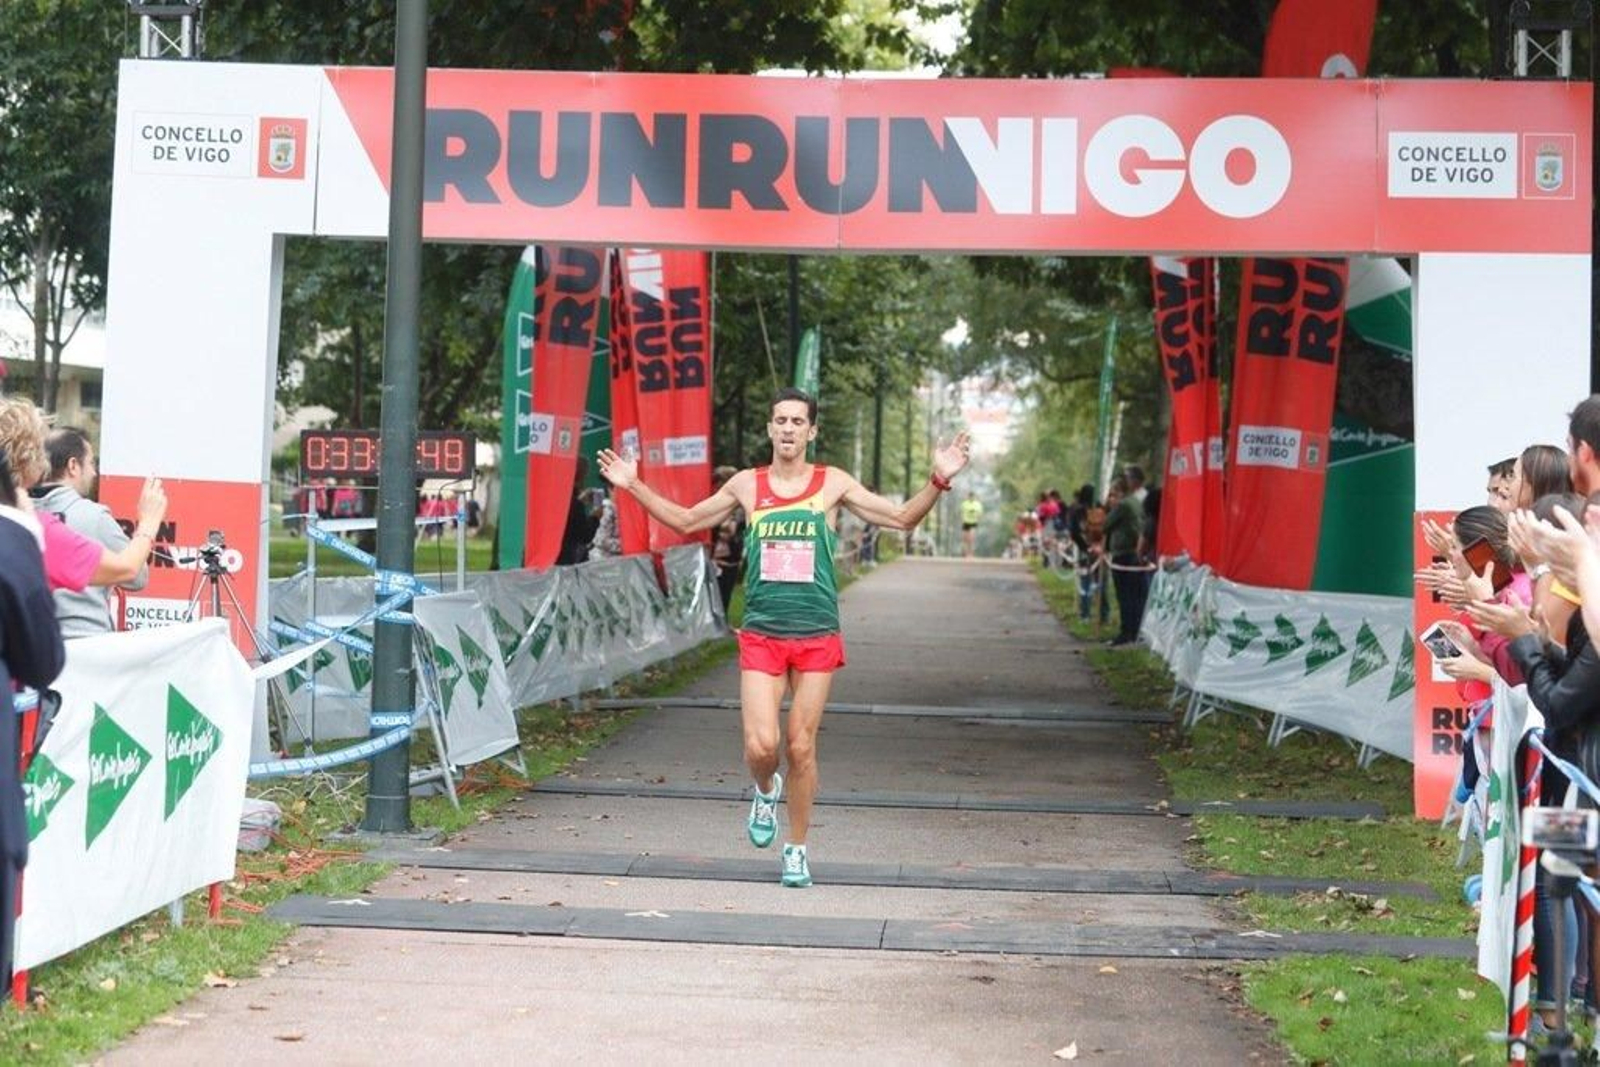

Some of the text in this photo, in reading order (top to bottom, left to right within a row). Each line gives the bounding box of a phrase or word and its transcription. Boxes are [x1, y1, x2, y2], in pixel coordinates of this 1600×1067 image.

[141, 125, 244, 145] CONCELLO
[152, 145, 231, 163] DE VIGO
[1397, 145, 1507, 163] CONCELLO
[1410, 167, 1494, 184] DE VIGO
[115, 518, 176, 543] RN
[758, 521, 818, 538] BIKILA
[125, 606, 193, 623] ONCELLO
